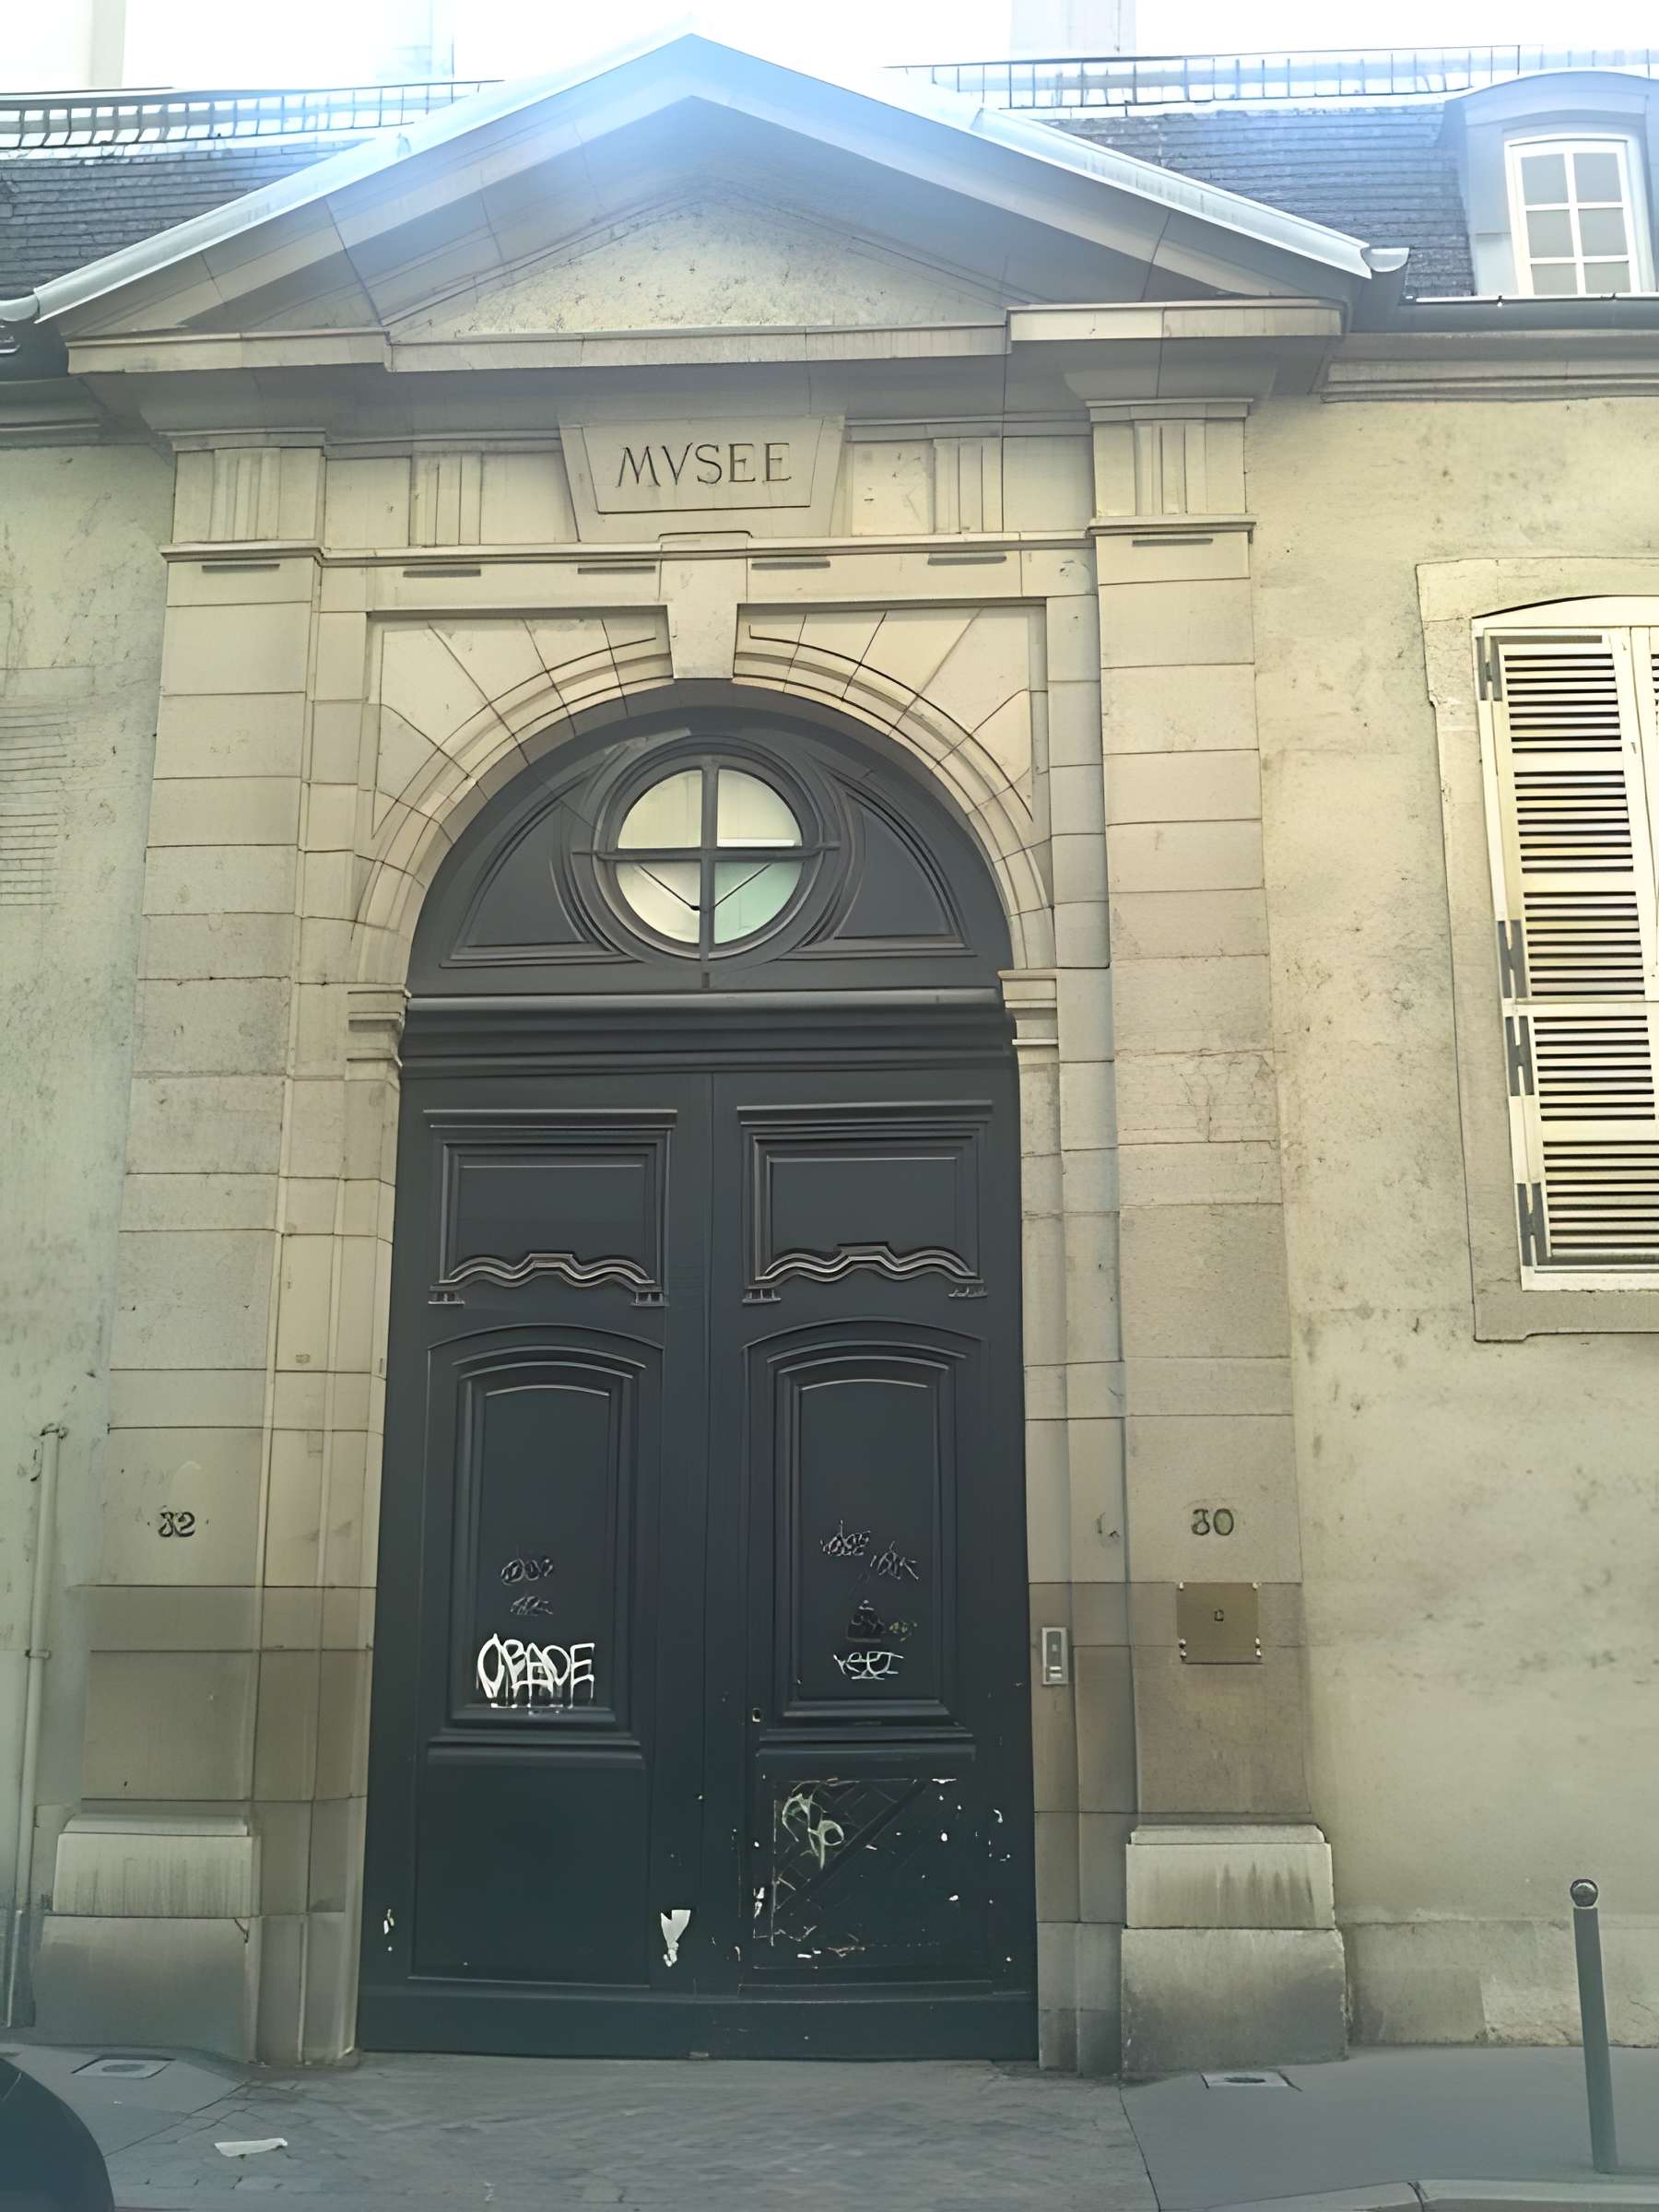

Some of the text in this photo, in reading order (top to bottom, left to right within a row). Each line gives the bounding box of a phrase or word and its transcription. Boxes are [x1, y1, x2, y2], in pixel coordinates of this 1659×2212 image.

[616, 441, 793, 488] MVSEE
[159, 1512, 195, 1537] 32
[1192, 1508, 1234, 1535] 30
